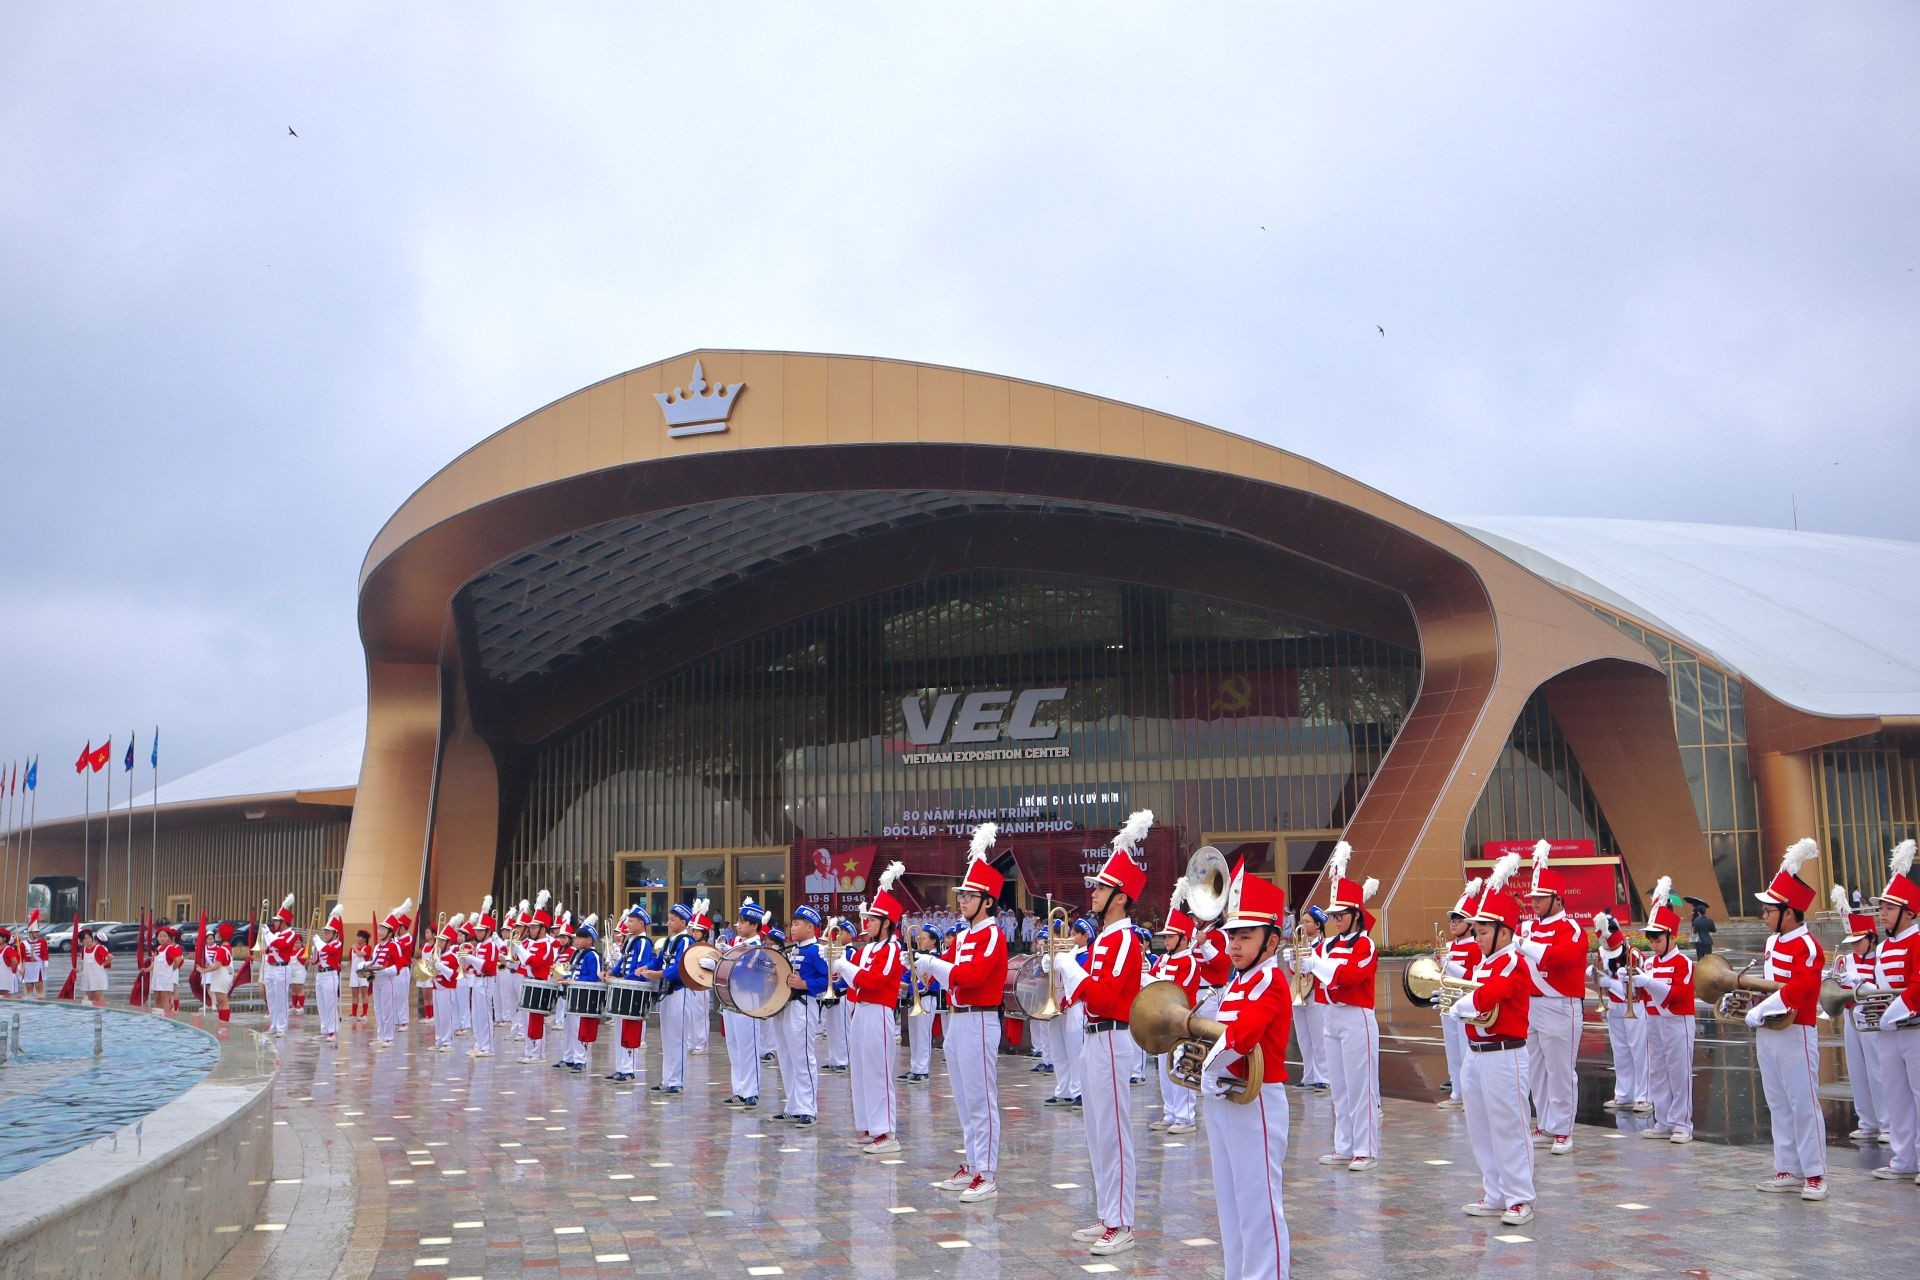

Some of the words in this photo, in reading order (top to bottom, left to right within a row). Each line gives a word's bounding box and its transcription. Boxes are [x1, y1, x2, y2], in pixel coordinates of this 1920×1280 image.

[901, 687, 1067, 745] VEC
[902, 751, 952, 764] VIETNAM
[953, 749, 1022, 762] EXPOSITION
[1024, 747, 1070, 759] CENTER
[902, 811, 920, 821] 80
[924, 807, 955, 821] NĂM
[958, 805, 996, 820] HÀNH
[883, 823, 910, 840] ĐỘC
[912, 822, 937, 840] LẬP
[947, 823, 964, 839] TỰ
[1037, 816, 1073, 832] PHÚC
[841, 876, 866, 892] 80
[842, 904, 860, 912] 202
